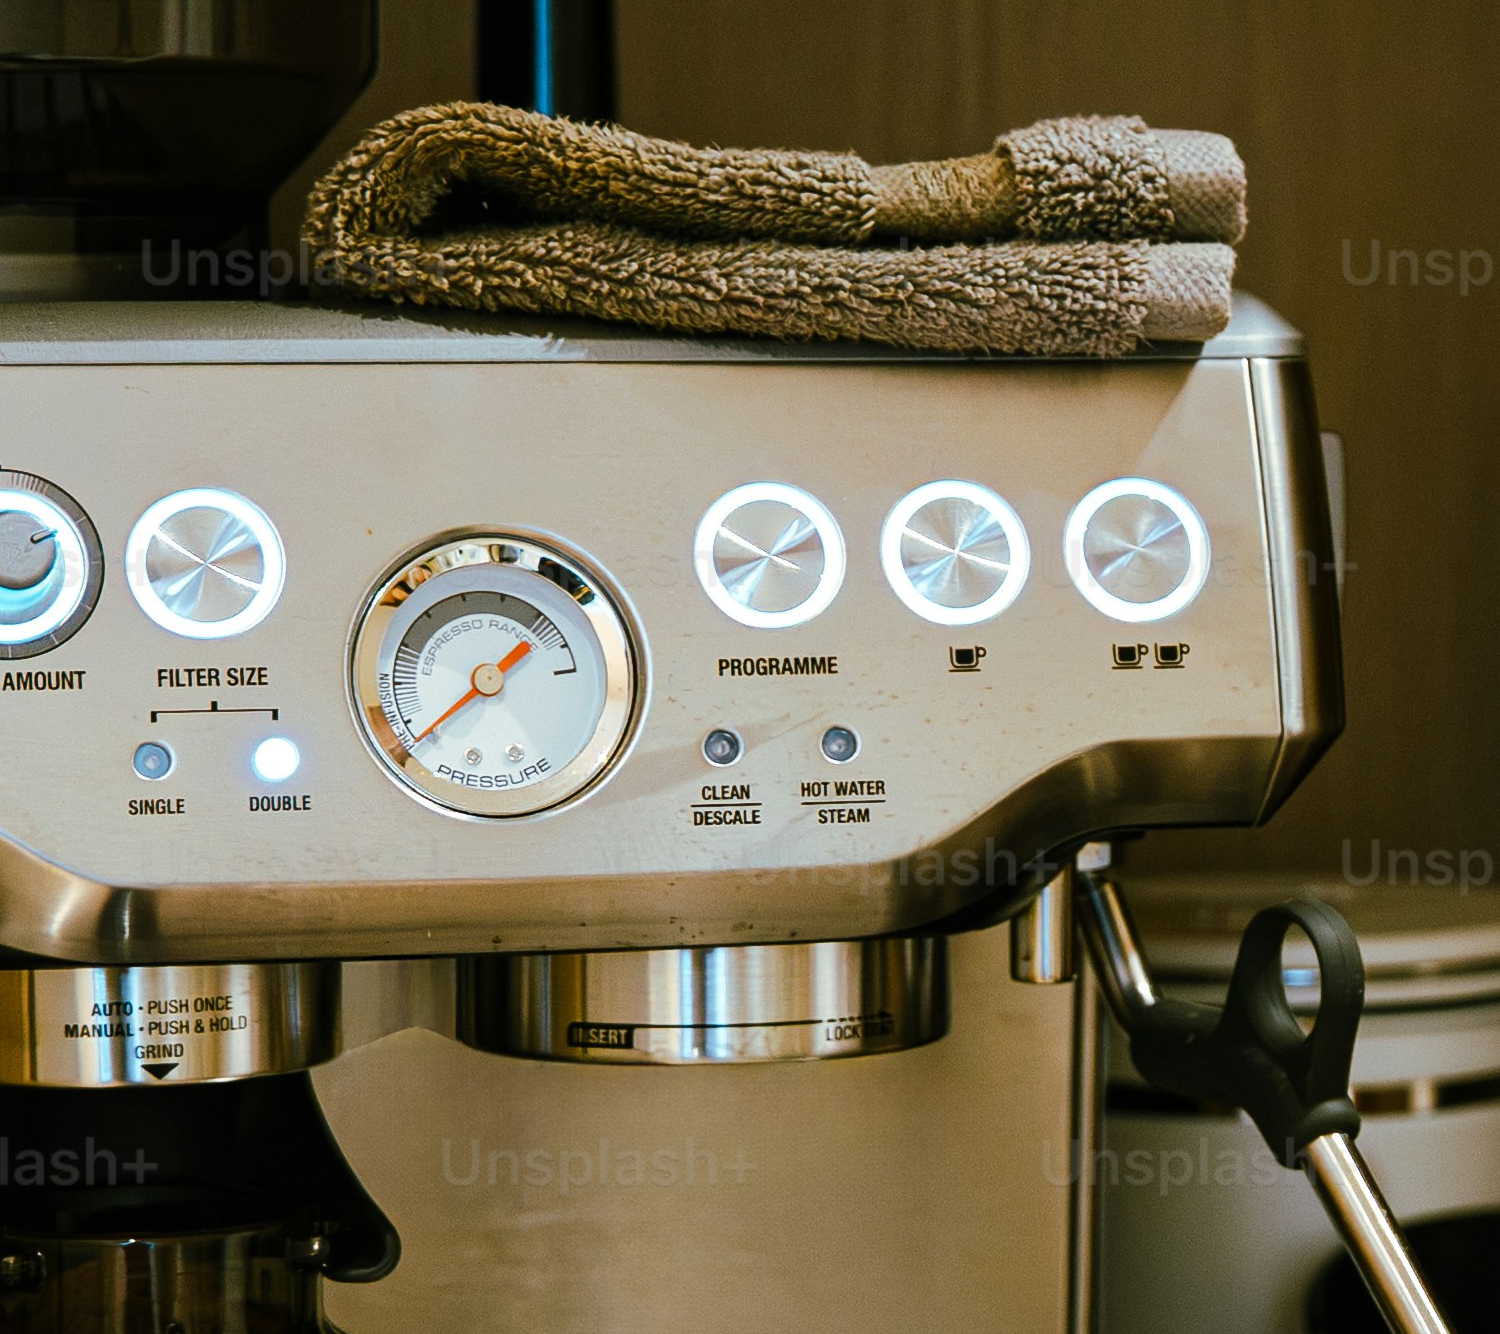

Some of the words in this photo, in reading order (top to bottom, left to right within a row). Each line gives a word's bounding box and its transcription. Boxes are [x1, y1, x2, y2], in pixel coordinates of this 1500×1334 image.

[421, 618, 484, 676] ESPRESSO
[718, 656, 839, 677] PROGRAMME
[2, 671, 86, 692] AMOUNT
[157, 668, 221, 687] FILTER
[226, 667, 268, 686] SIZE
[436, 757, 552, 788] PRESSURE
[701, 784, 751, 801] CLEAN
[801, 781, 830, 797] HOT
[834, 780, 886, 796] WATER
[128, 798, 186, 815] SINGLE
[249, 795, 311, 812] DOUBLE
[693, 809, 762, 826] DESCALE
[818, 808, 871, 824] STEAM
[91, 1001, 134, 1017] AUTO
[147, 998, 190, 1015] PUSH
[193, 995, 234, 1013] ONCE
[64, 1023, 135, 1038] MANUAL
[148, 1020, 190, 1036] PUSH
[209, 1015, 248, 1032] HOLD
[134, 1043, 185, 1059] GRIND
